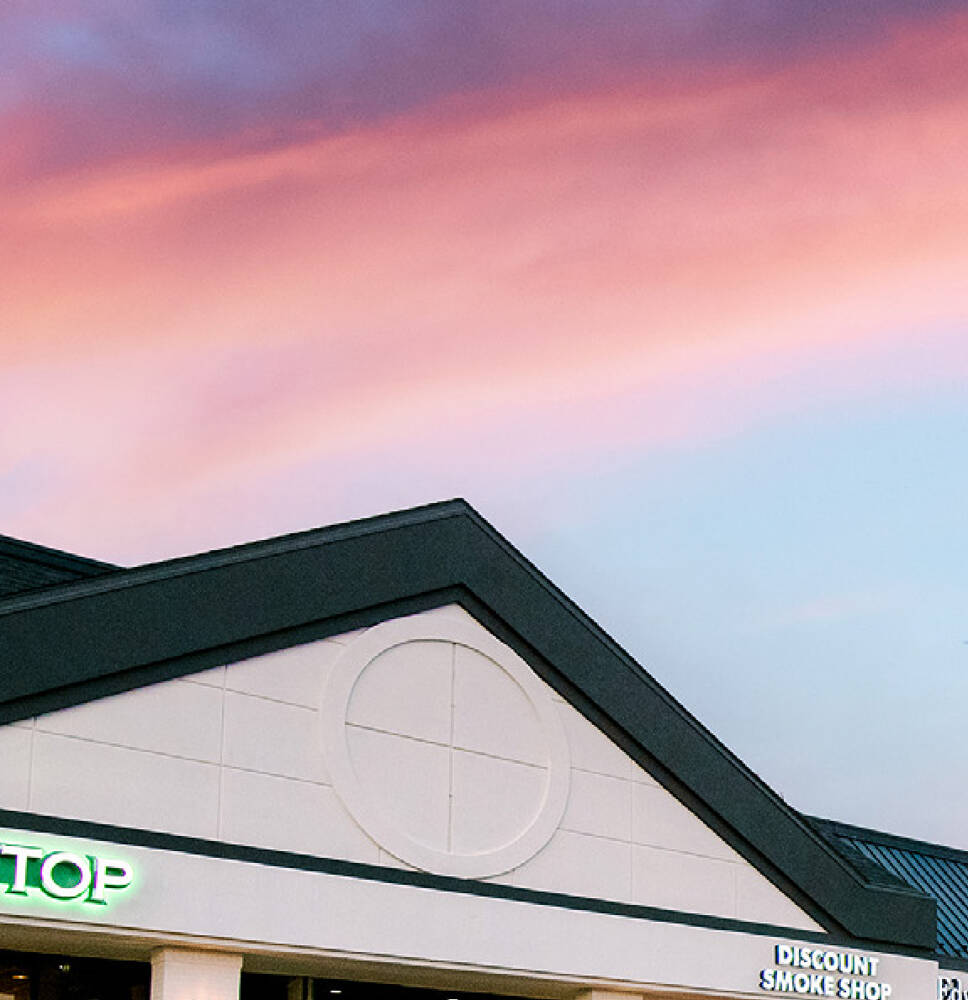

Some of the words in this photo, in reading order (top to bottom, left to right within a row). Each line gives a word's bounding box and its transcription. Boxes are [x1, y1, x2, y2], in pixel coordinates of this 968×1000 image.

[775, 944, 879, 976] DISCOUNT
[760, 968, 835, 997] SMOKE
[837, 978, 892, 1000] SHOP
